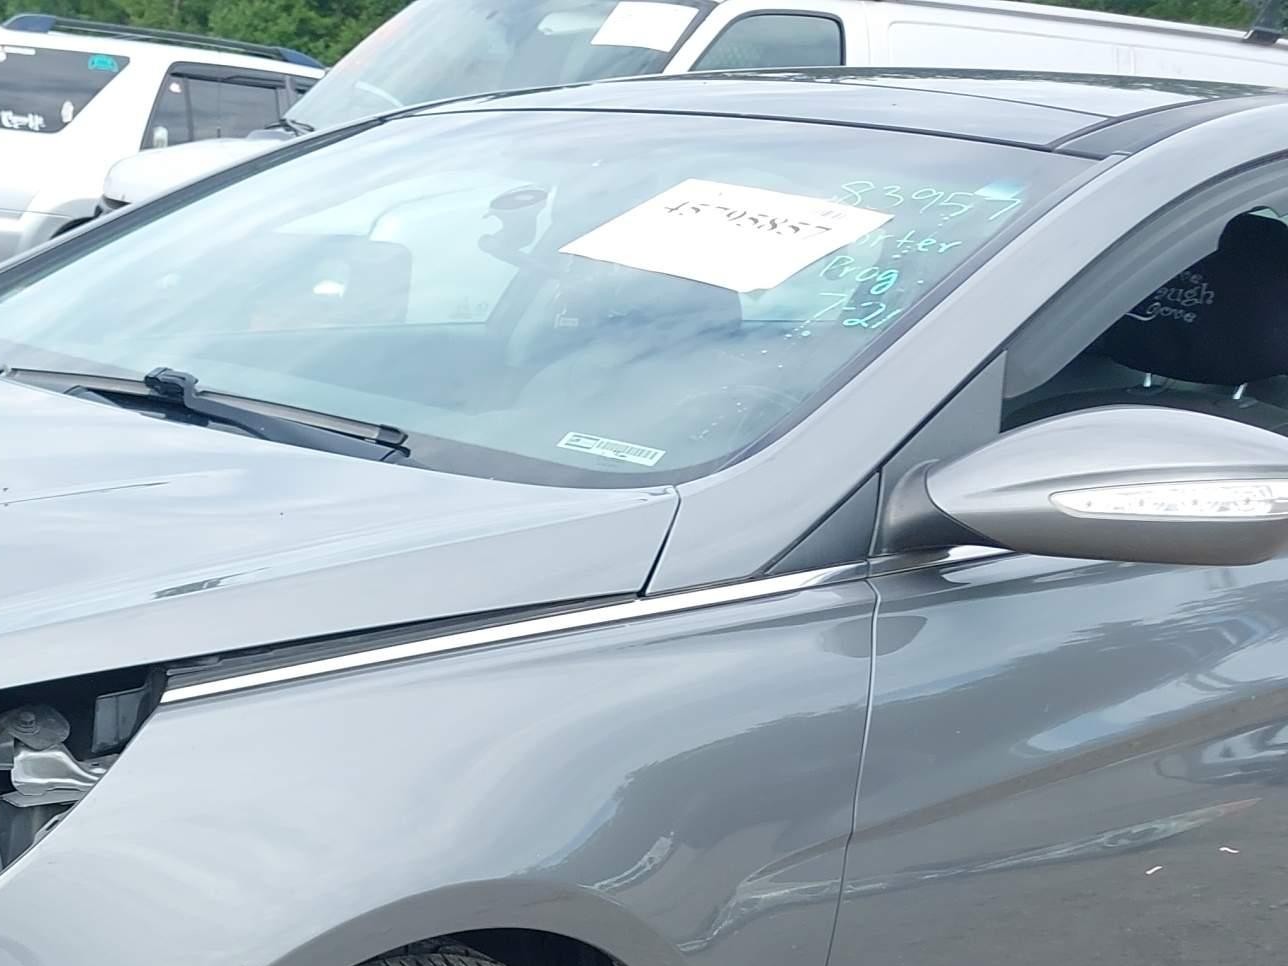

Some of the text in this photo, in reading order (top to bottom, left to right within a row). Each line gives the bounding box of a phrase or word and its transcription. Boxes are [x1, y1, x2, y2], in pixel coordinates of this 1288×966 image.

[836, 180, 1022, 221] 83957
[856, 230, 963, 253] orter
[1154, 282, 1216, 307] augh
